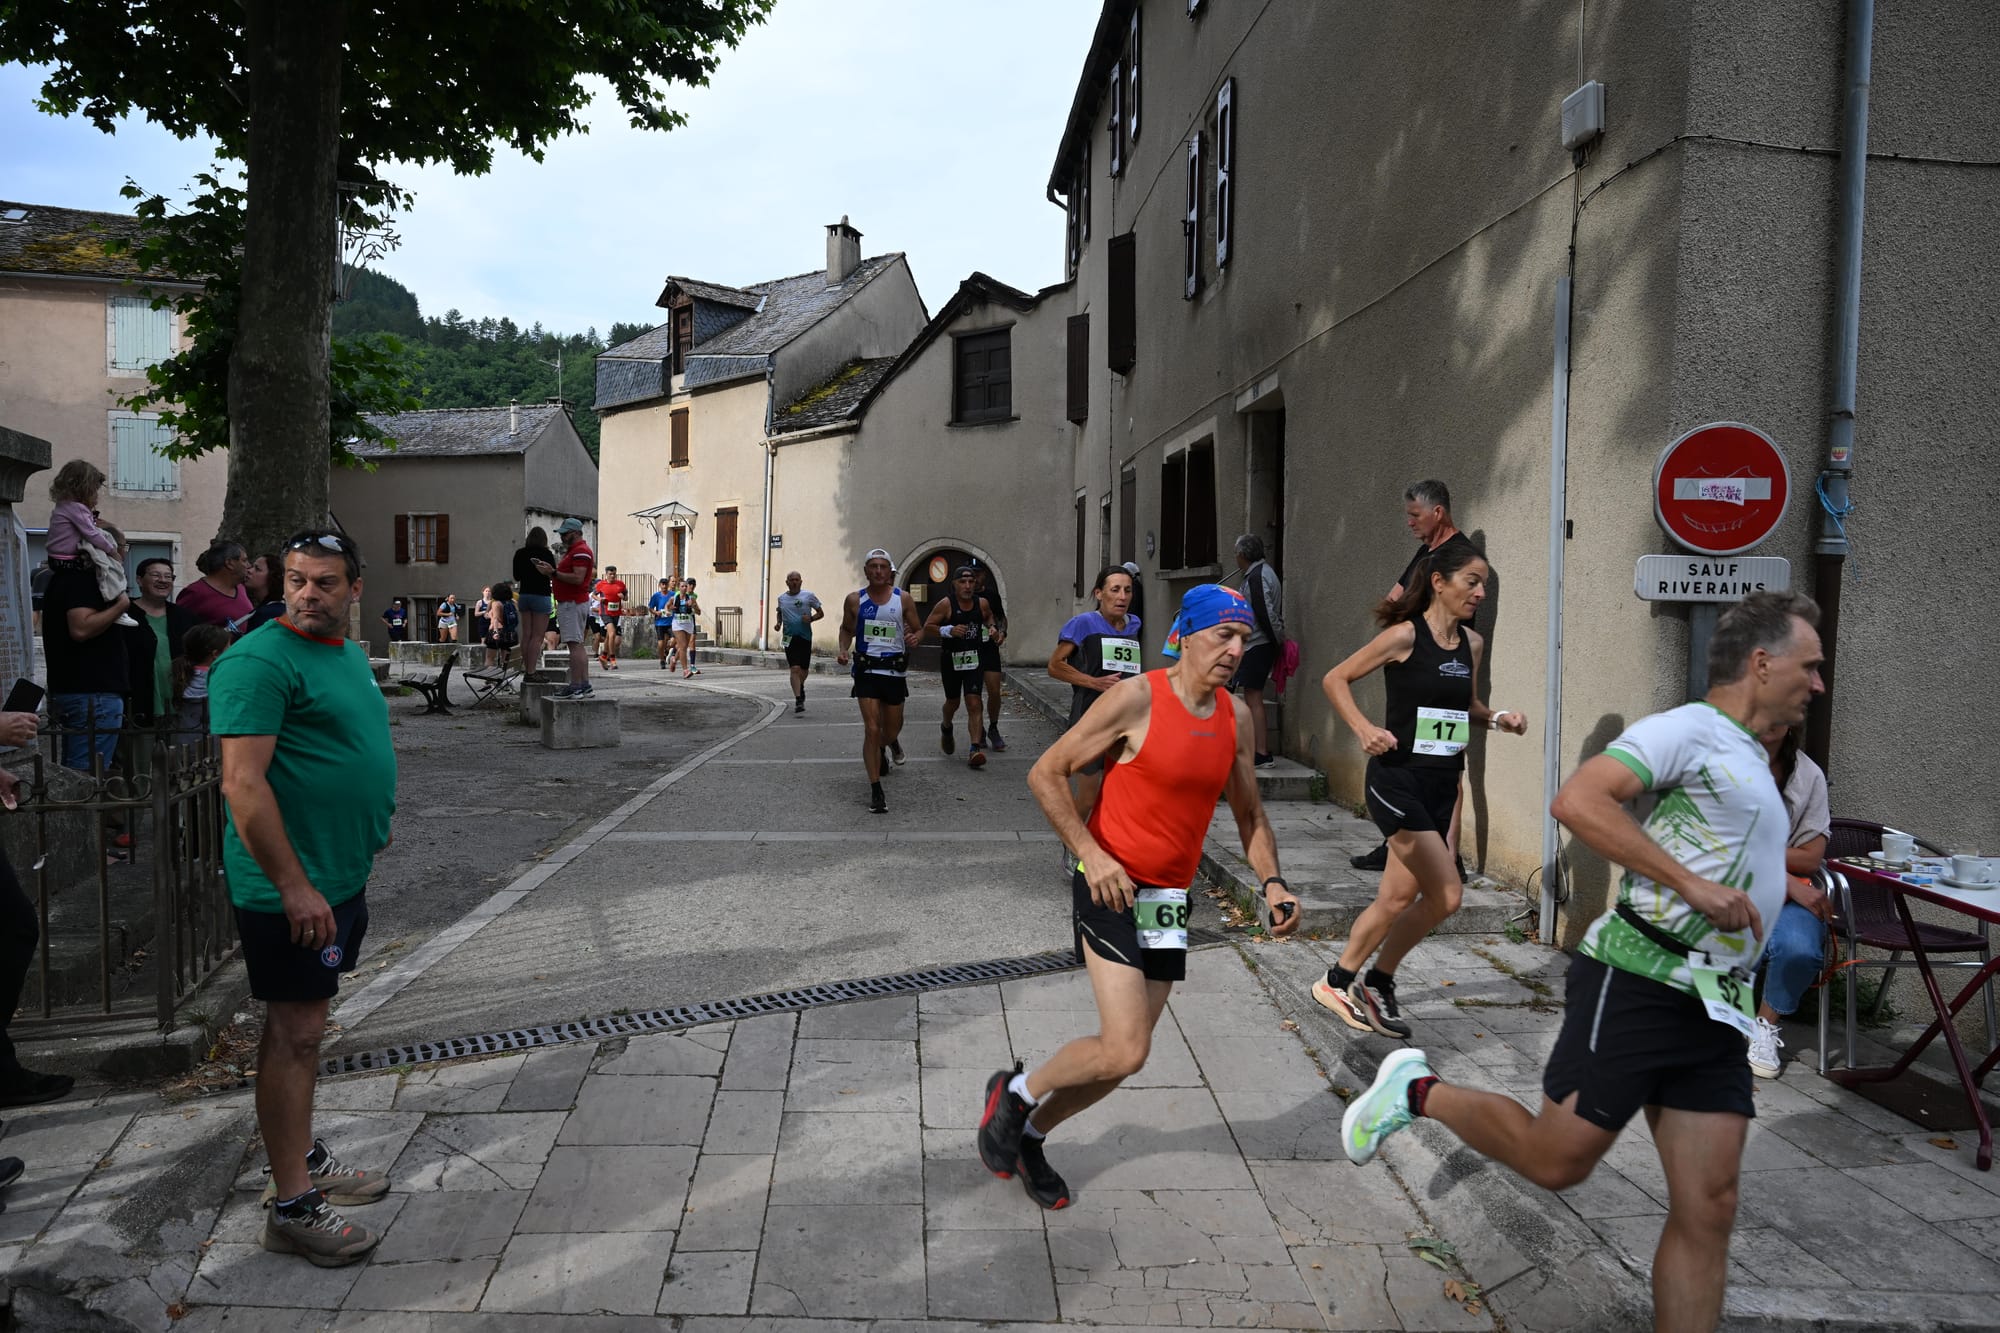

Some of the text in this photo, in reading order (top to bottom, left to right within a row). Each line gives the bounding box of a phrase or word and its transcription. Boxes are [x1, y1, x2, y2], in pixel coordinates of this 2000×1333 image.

[1688, 563, 1738, 577] SAUF
[872, 626, 886, 639] 61
[960, 656, 973, 664] 12
[1114, 647, 1132, 662] 53
[1432, 721, 1457, 741] 17
[1156, 904, 1186, 928] 68
[1717, 974, 1743, 1012] 52
